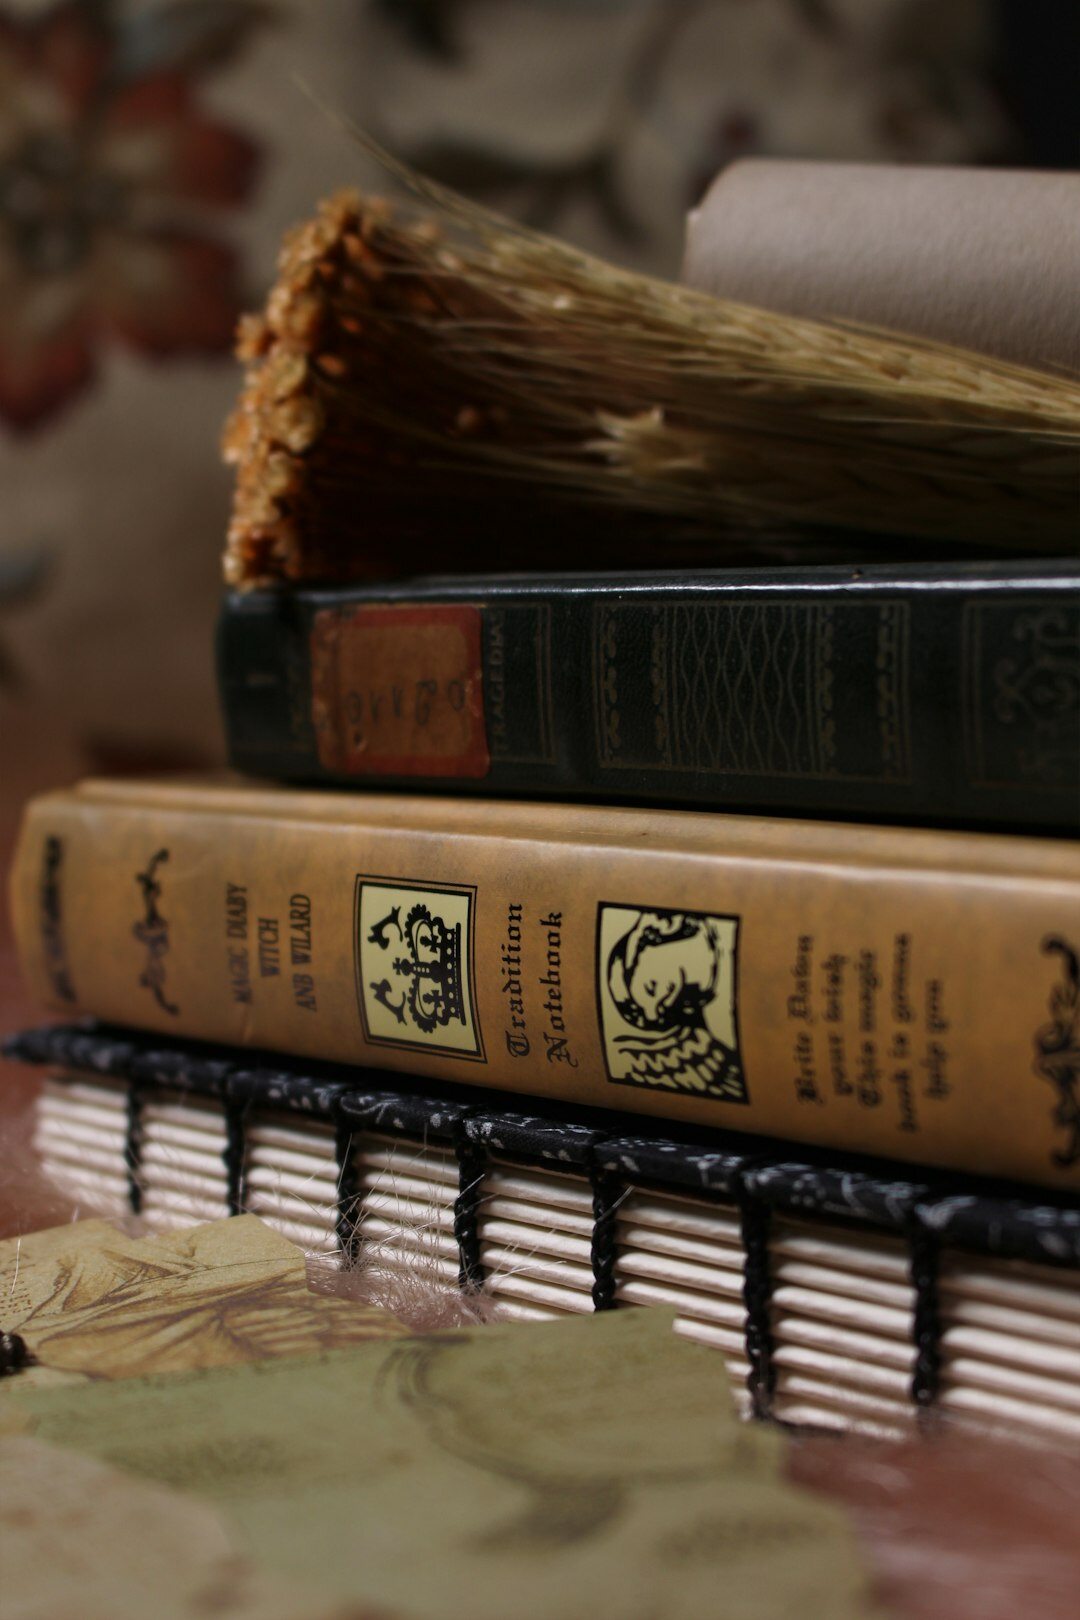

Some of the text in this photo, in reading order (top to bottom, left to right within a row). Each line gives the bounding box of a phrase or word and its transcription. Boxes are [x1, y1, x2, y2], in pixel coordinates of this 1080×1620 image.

[258, 917, 280, 977] WITCH
[290, 893, 312, 965] WILARD
[502, 903, 531, 1058] Tradition
[540, 911, 578, 1068] Notebook
